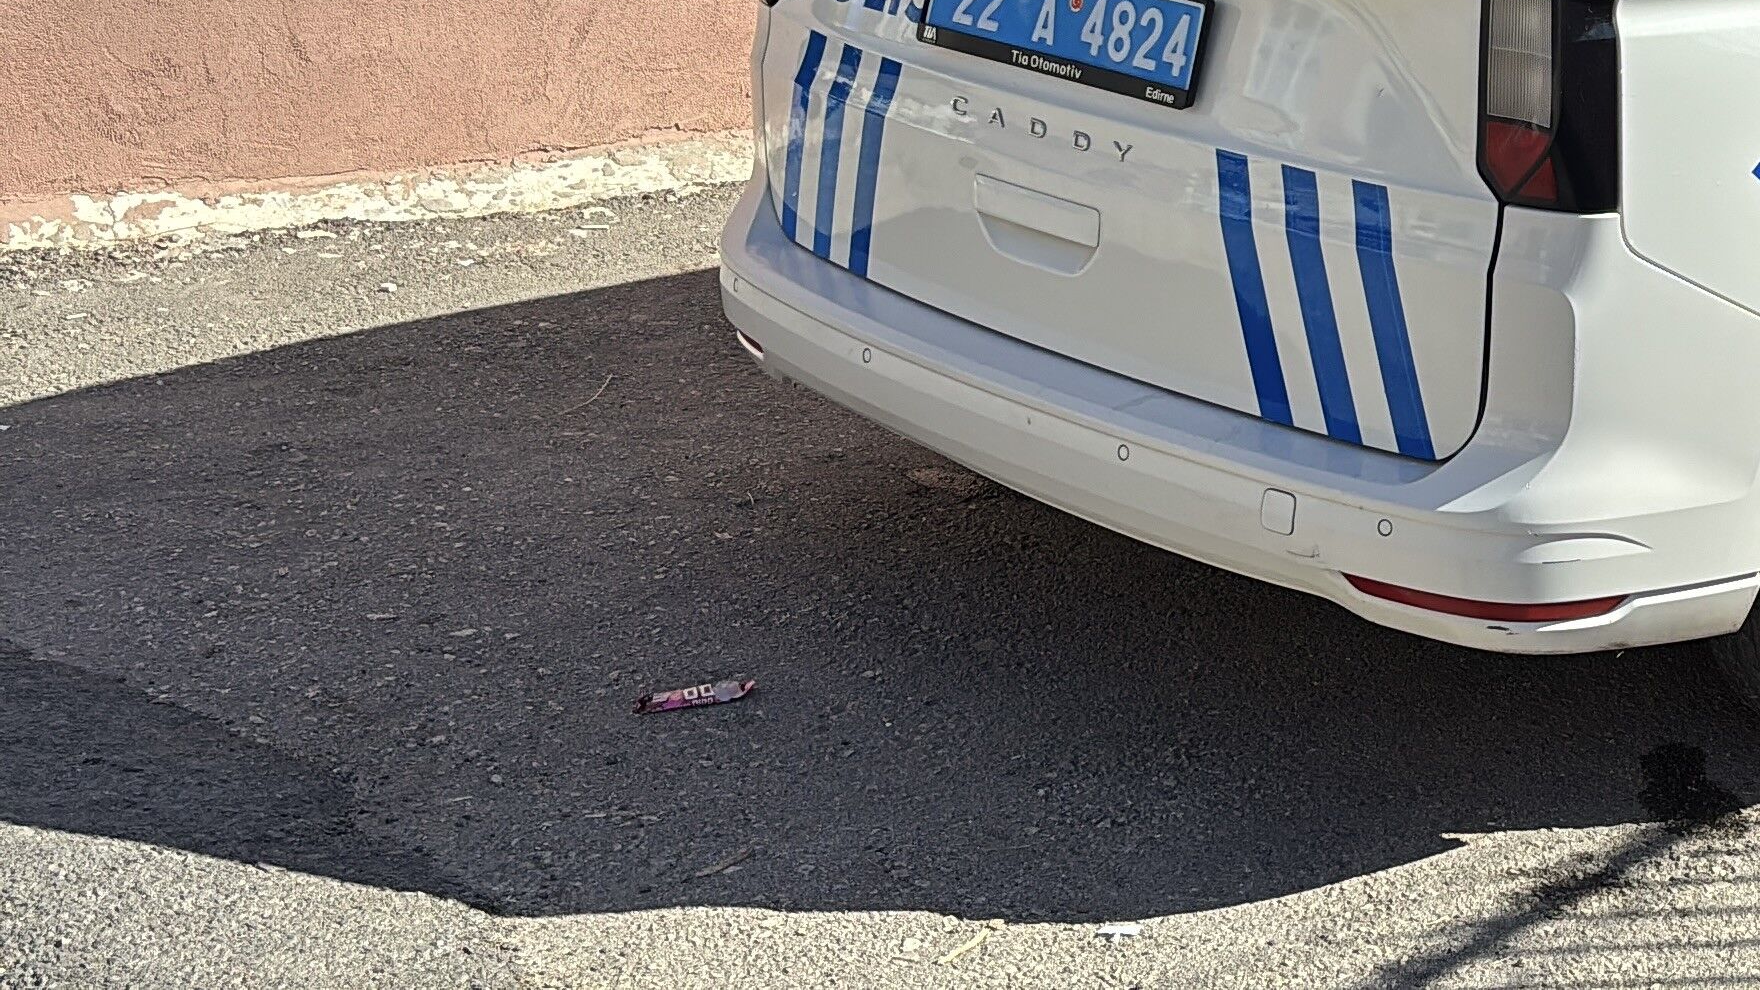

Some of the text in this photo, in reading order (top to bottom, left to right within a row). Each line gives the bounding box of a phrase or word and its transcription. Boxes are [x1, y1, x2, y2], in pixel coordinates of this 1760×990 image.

[1011, 49, 1083, 80] Tia Otomotiv
[1145, 86, 1175, 105] Edirne
[950, 95, 1133, 162] CADDY
